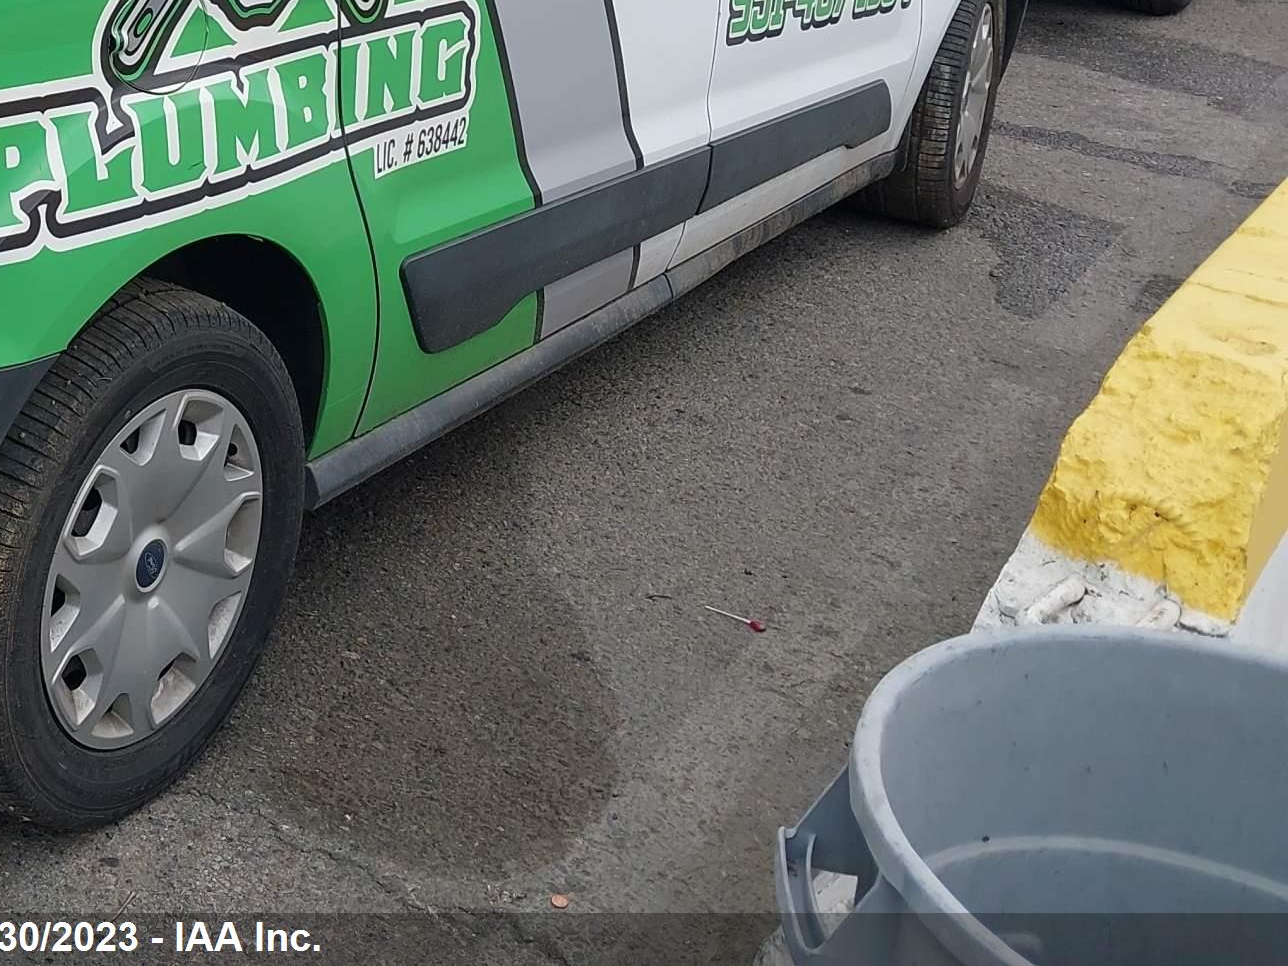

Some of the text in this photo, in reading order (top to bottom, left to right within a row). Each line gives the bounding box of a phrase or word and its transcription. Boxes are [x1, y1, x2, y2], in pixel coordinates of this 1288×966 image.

[376, 116, 467, 174] LIC. # 638442
